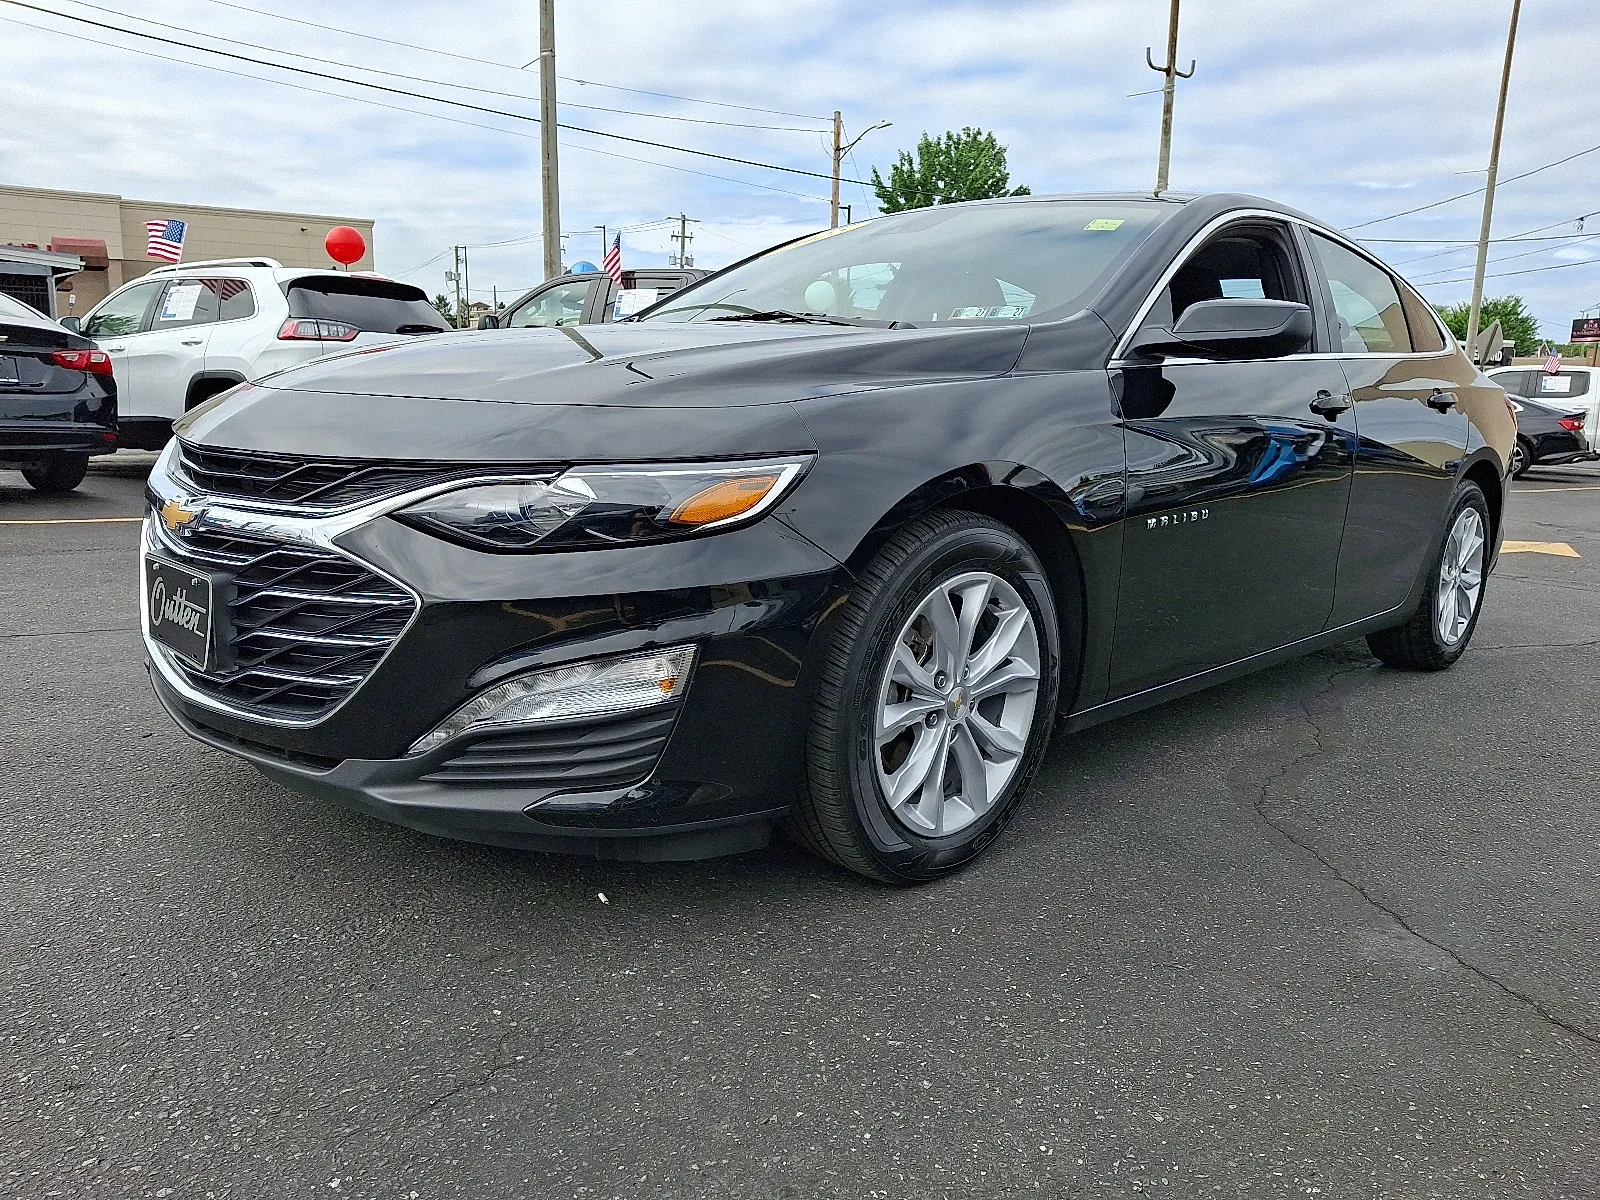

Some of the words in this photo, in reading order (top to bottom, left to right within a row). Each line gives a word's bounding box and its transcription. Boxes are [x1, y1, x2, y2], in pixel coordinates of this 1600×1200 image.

[975, 308, 987, 317] 27
[1013, 307, 1024, 317] 27
[1146, 509, 1209, 530] MALIBU
